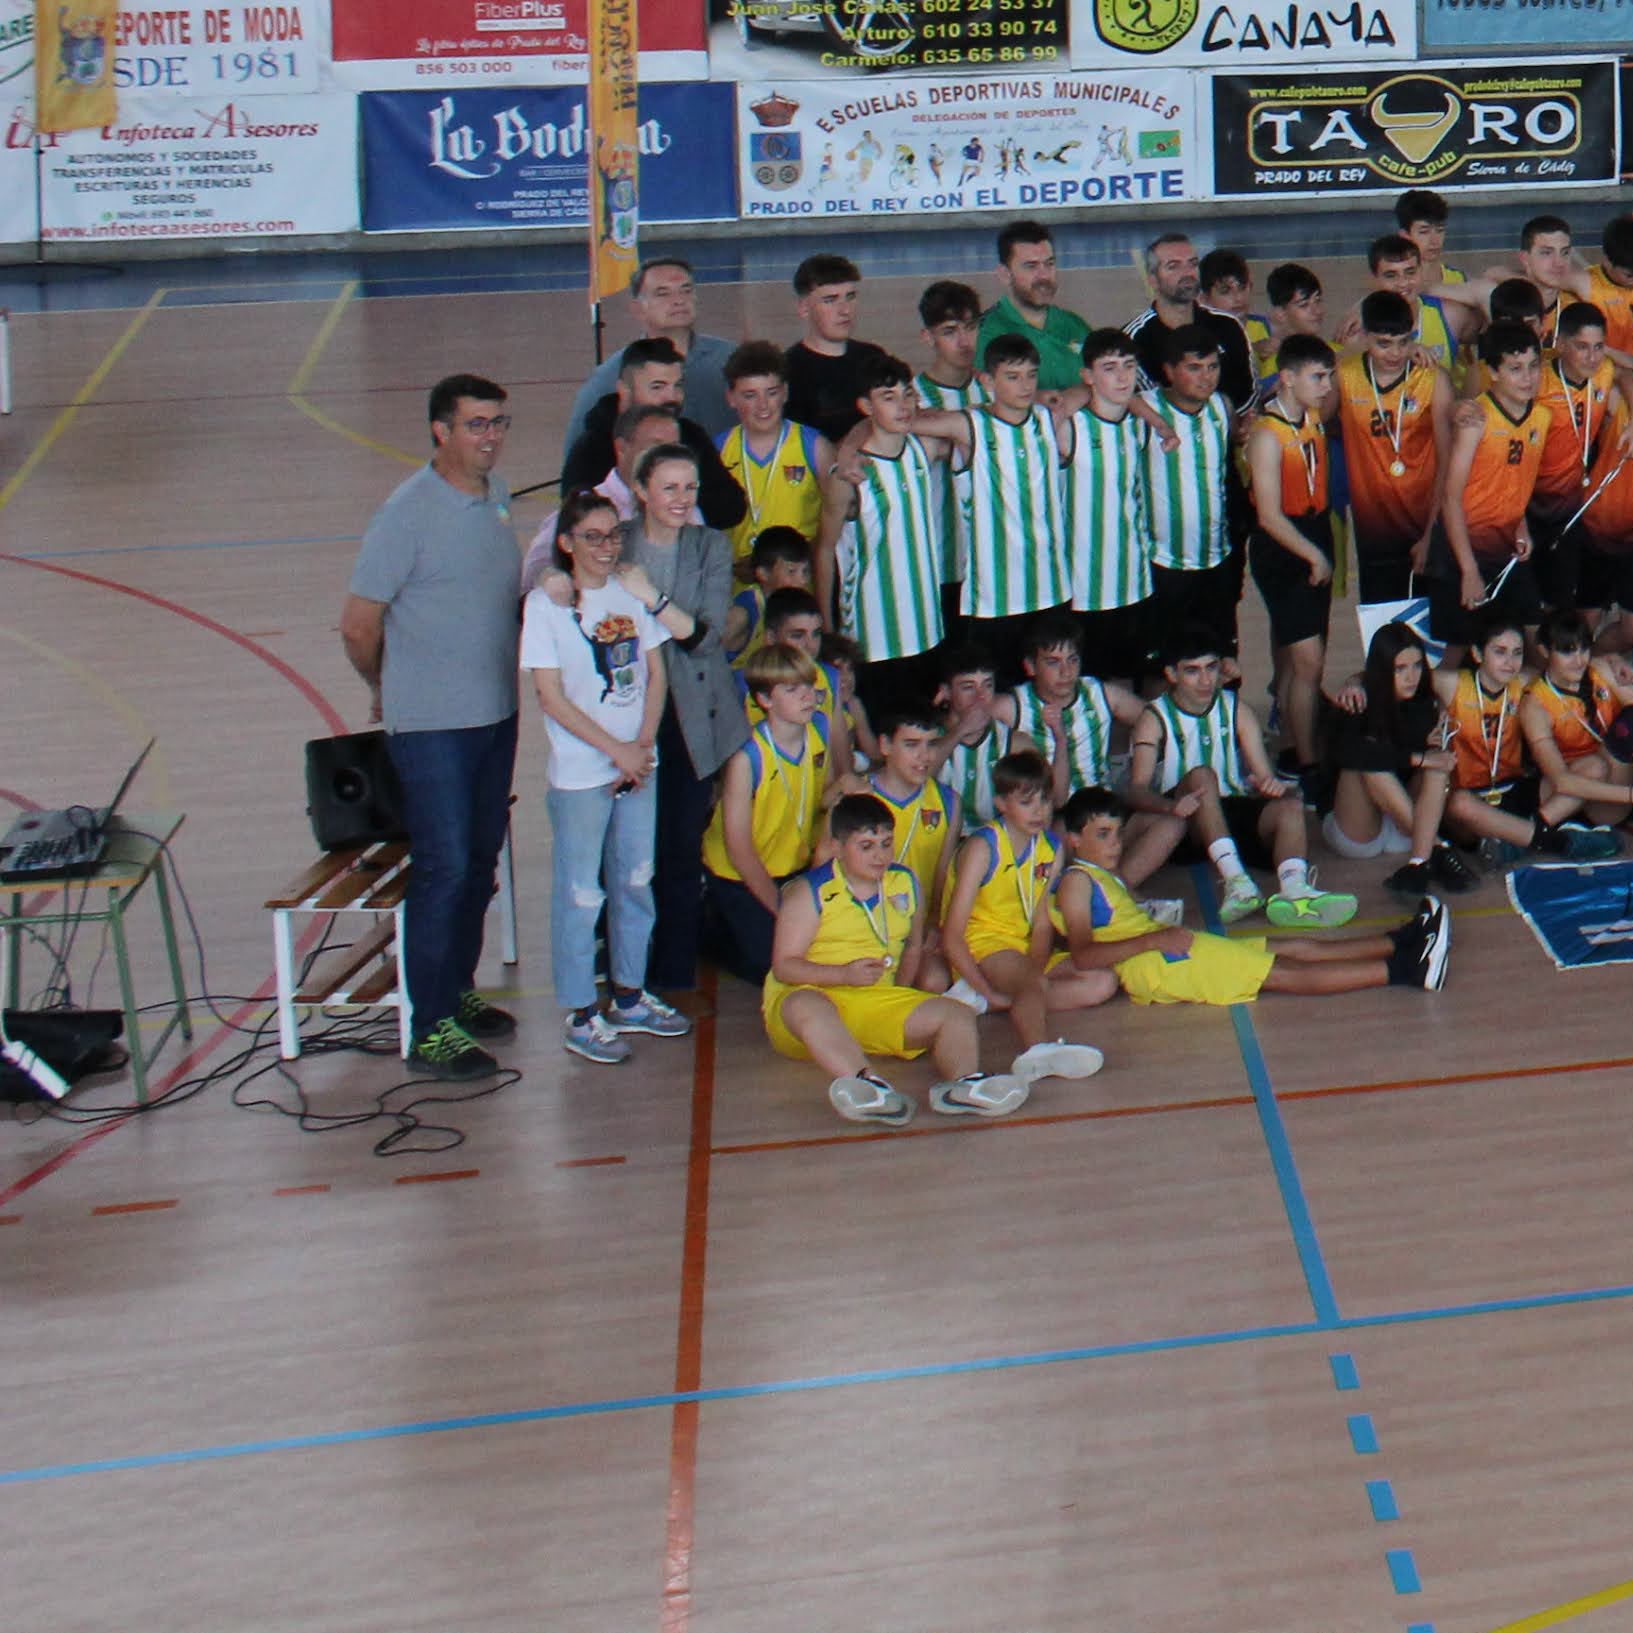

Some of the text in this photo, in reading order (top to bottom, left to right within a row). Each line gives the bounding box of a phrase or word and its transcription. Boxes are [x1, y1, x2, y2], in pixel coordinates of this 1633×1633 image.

[205, 7, 302, 43] DE MODA
[475, 2, 562, 18] FiberPlus
[842, 20, 1057, 40] Arturo: 610 33 90 74
[1201, 2, 1395, 53] CANAYA
[212, 51, 299, 82] 1981
[416, 62, 512, 74] 856 503 000
[821, 46, 1057, 67] Carmelo: 635 65 86 99
[195, 103, 319, 139] Asesores
[815, 81, 1181, 134] ESCUELAS DEPORTIVAS MUNICIPALES
[133, 194, 196, 205] SEGUROS
[750, 169, 1184, 214] PRADO DEL REY CON EL DEPORTE
